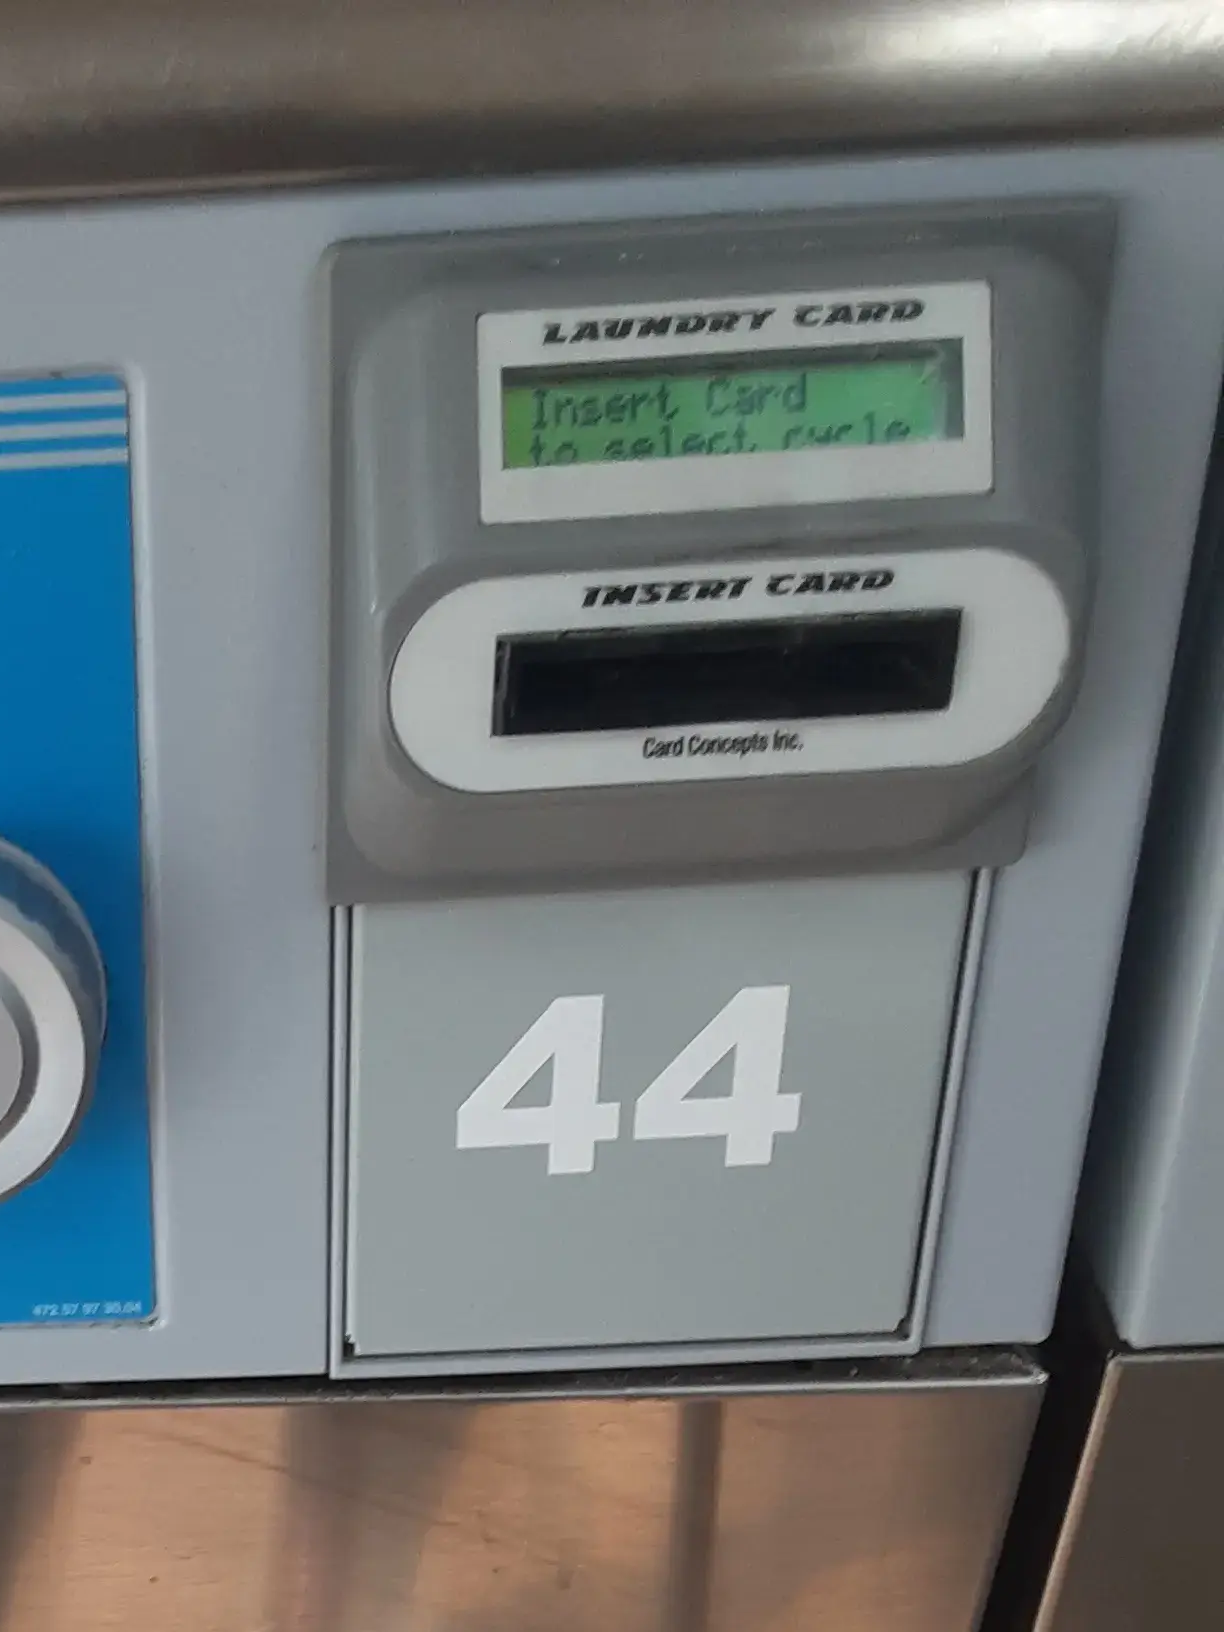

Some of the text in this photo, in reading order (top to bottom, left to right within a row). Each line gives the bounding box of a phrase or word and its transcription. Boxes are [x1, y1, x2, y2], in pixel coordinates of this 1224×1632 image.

[541, 298, 926, 347] LAUNDRY CARD
[530, 373, 808, 431] Insert Card
[530, 436, 578, 466] to
[602, 421, 758, 462] select
[581, 568, 895, 608] INSERT CARD
[642, 729, 804, 759] Card Concepts Inc.
[456, 984, 802, 1176] 44
